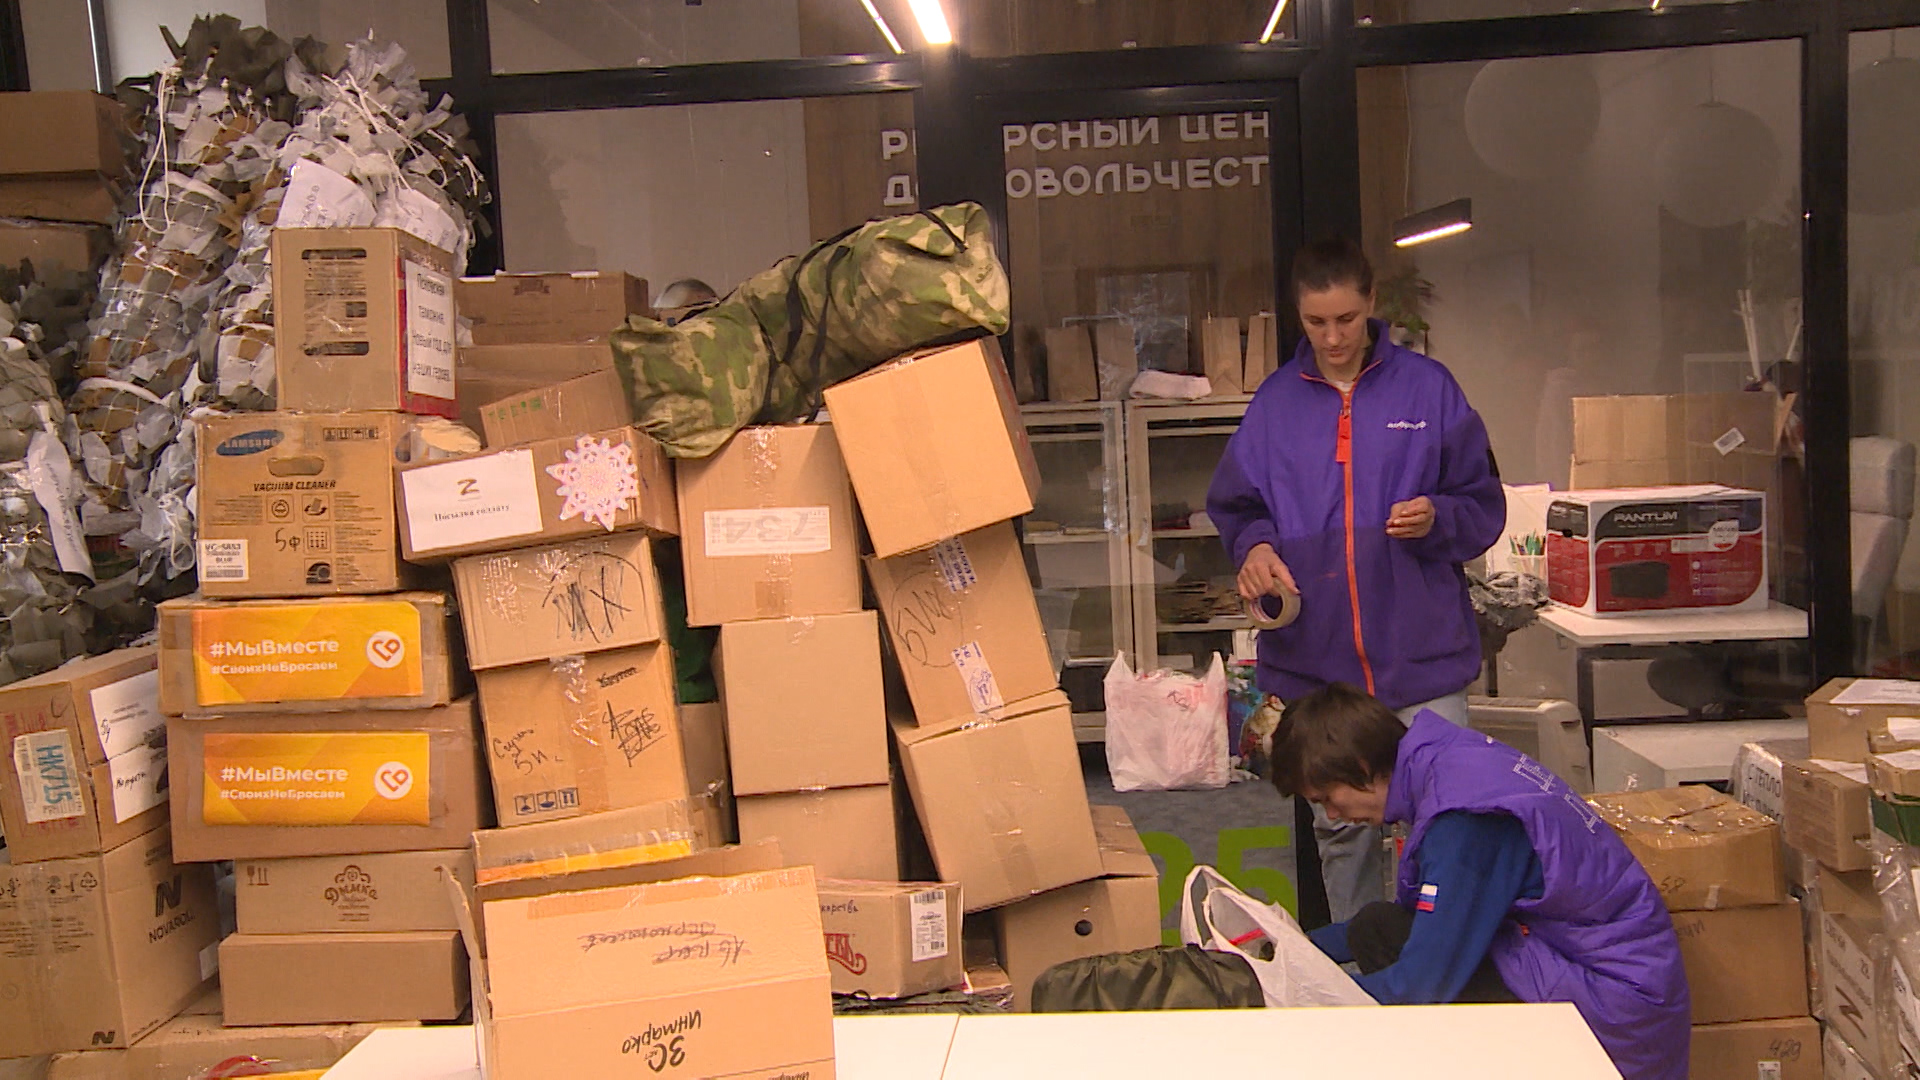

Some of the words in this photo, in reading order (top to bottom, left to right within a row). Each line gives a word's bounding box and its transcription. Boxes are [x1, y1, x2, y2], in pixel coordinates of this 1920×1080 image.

[881, 128, 918, 160] Р
[1005, 155, 1270, 199] ОВОЛЬЧЕСТ
[884, 173, 919, 206] Д
[253, 482, 294, 493] VACUUM
[296, 480, 336, 491] CLEANER
[1614, 511, 1678, 522] PANTUM
[210, 639, 340, 658] #МыВместе
[210, 661, 338, 675] #СвоихНеБросаем
[221, 766, 349, 783] #МыВместе
[220, 788, 346, 801] #СвоихНеБросаем
